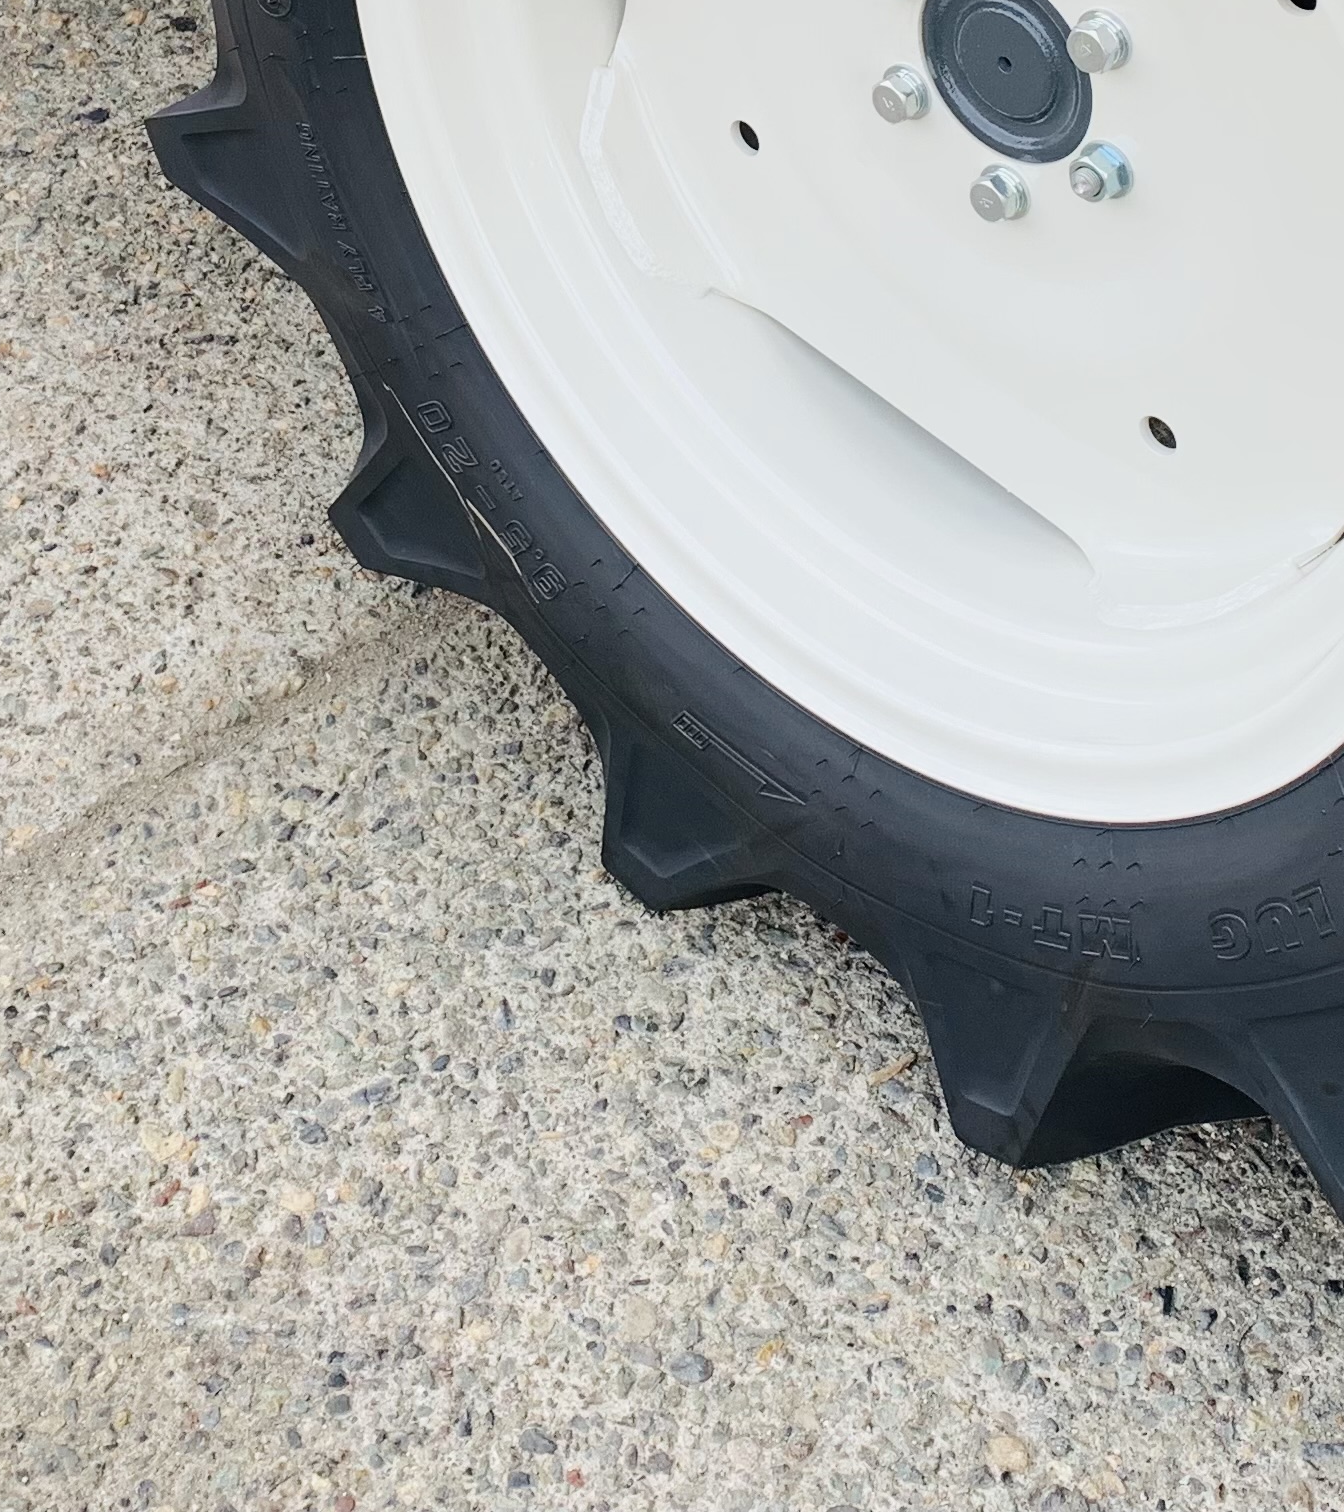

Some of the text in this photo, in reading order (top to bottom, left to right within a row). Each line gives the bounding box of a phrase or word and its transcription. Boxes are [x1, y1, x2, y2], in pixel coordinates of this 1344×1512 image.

[295, 122, 349, 234] RATING
[337, 238, 375, 294] PLY
[1209, 879, 1338, 960] LUG
